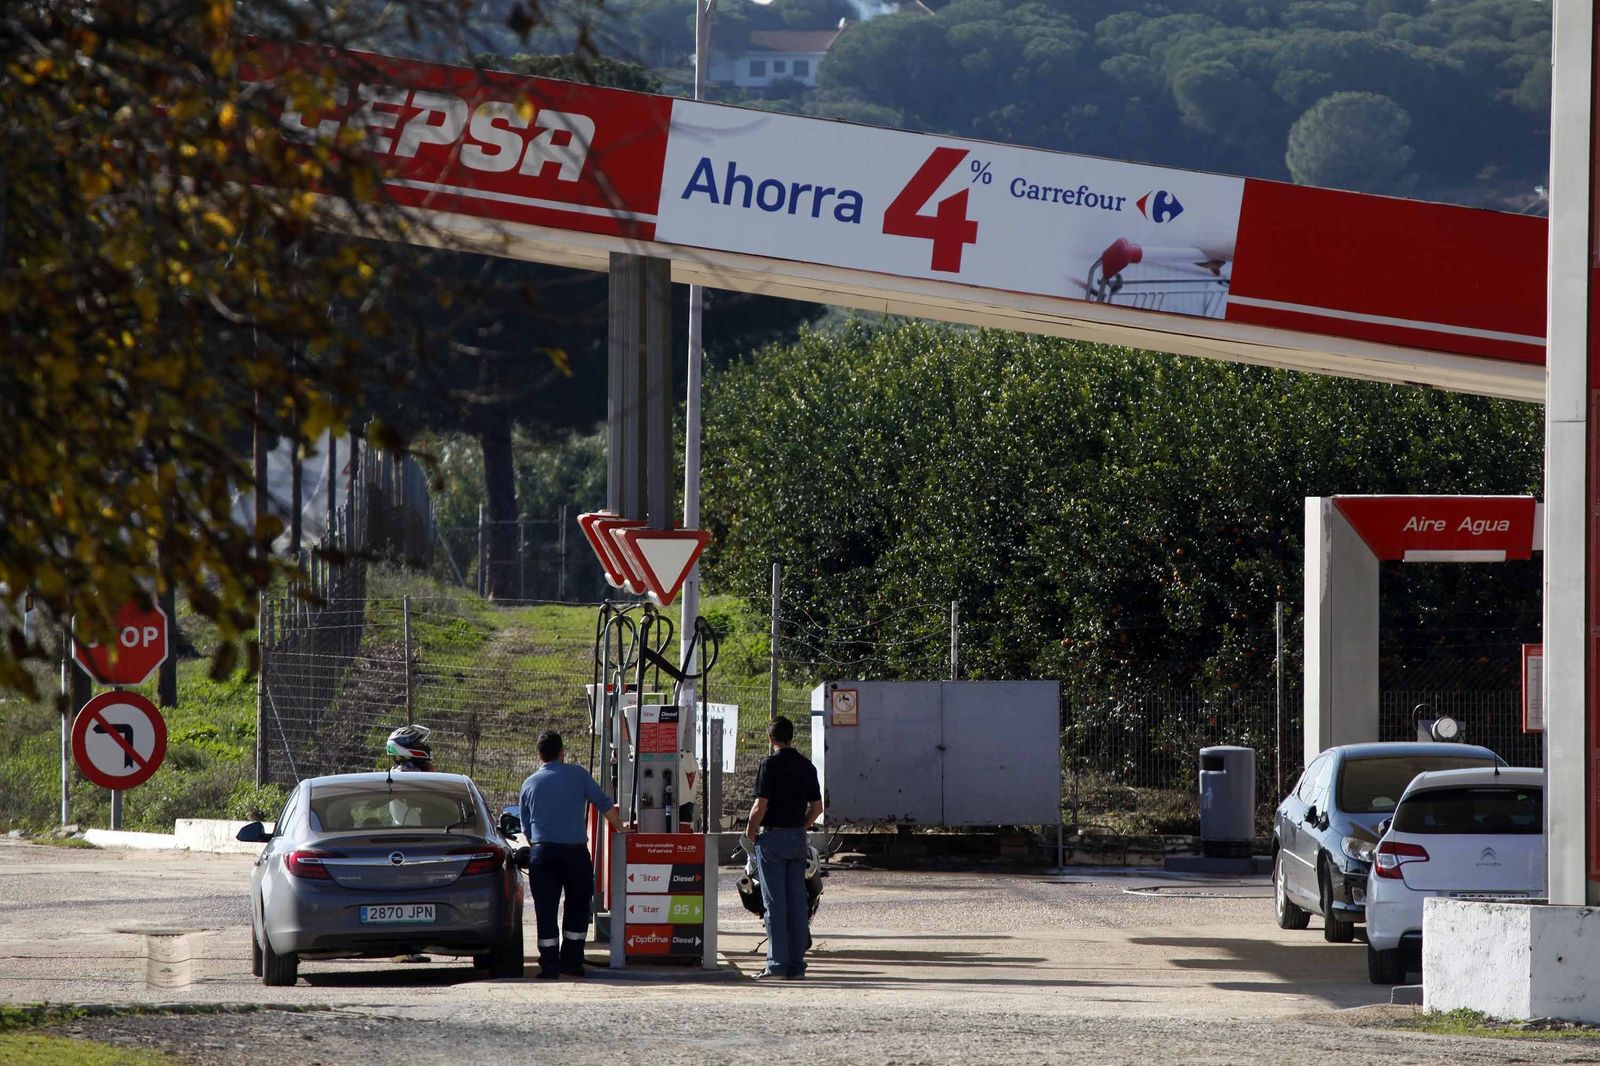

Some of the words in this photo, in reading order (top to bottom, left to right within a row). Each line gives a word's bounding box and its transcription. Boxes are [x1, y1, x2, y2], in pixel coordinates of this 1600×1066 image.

[279, 83, 596, 182] CEPSA
[680, 156, 864, 224] Ahorra
[1009, 177, 1127, 212] Carrefour
[1402, 516, 1447, 532] Aire
[1456, 516, 1510, 535] Agua
[369, 906, 404, 920] 2870
[408, 906, 433, 919] JPN
[673, 904, 689, 915] 95
[672, 936, 694, 944] Diesel
